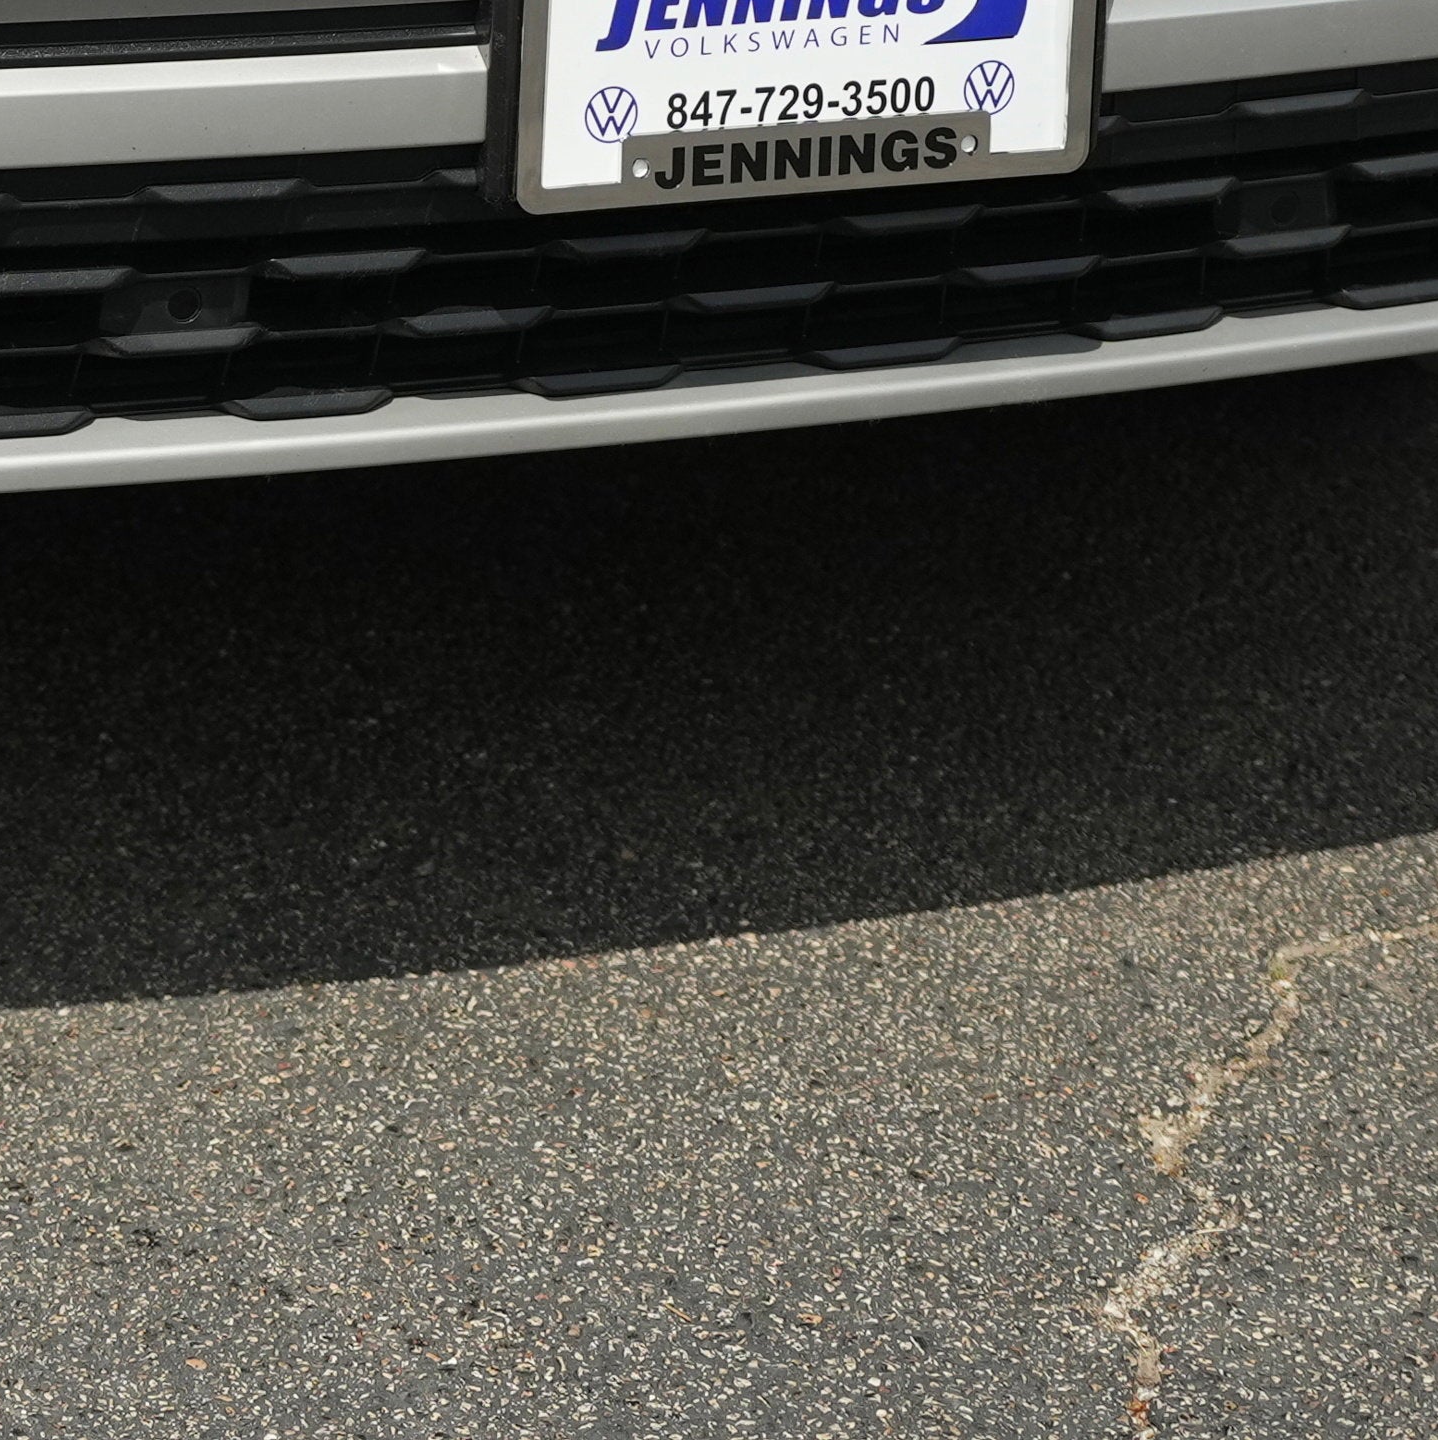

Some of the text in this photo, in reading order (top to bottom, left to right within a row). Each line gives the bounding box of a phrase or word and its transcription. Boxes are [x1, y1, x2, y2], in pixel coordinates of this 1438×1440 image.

[644, 23, 901, 59] VOLKSWAGEN
[667, 76, 936, 130] 847-729-3500
[654, 126, 958, 191] JENNINGS
